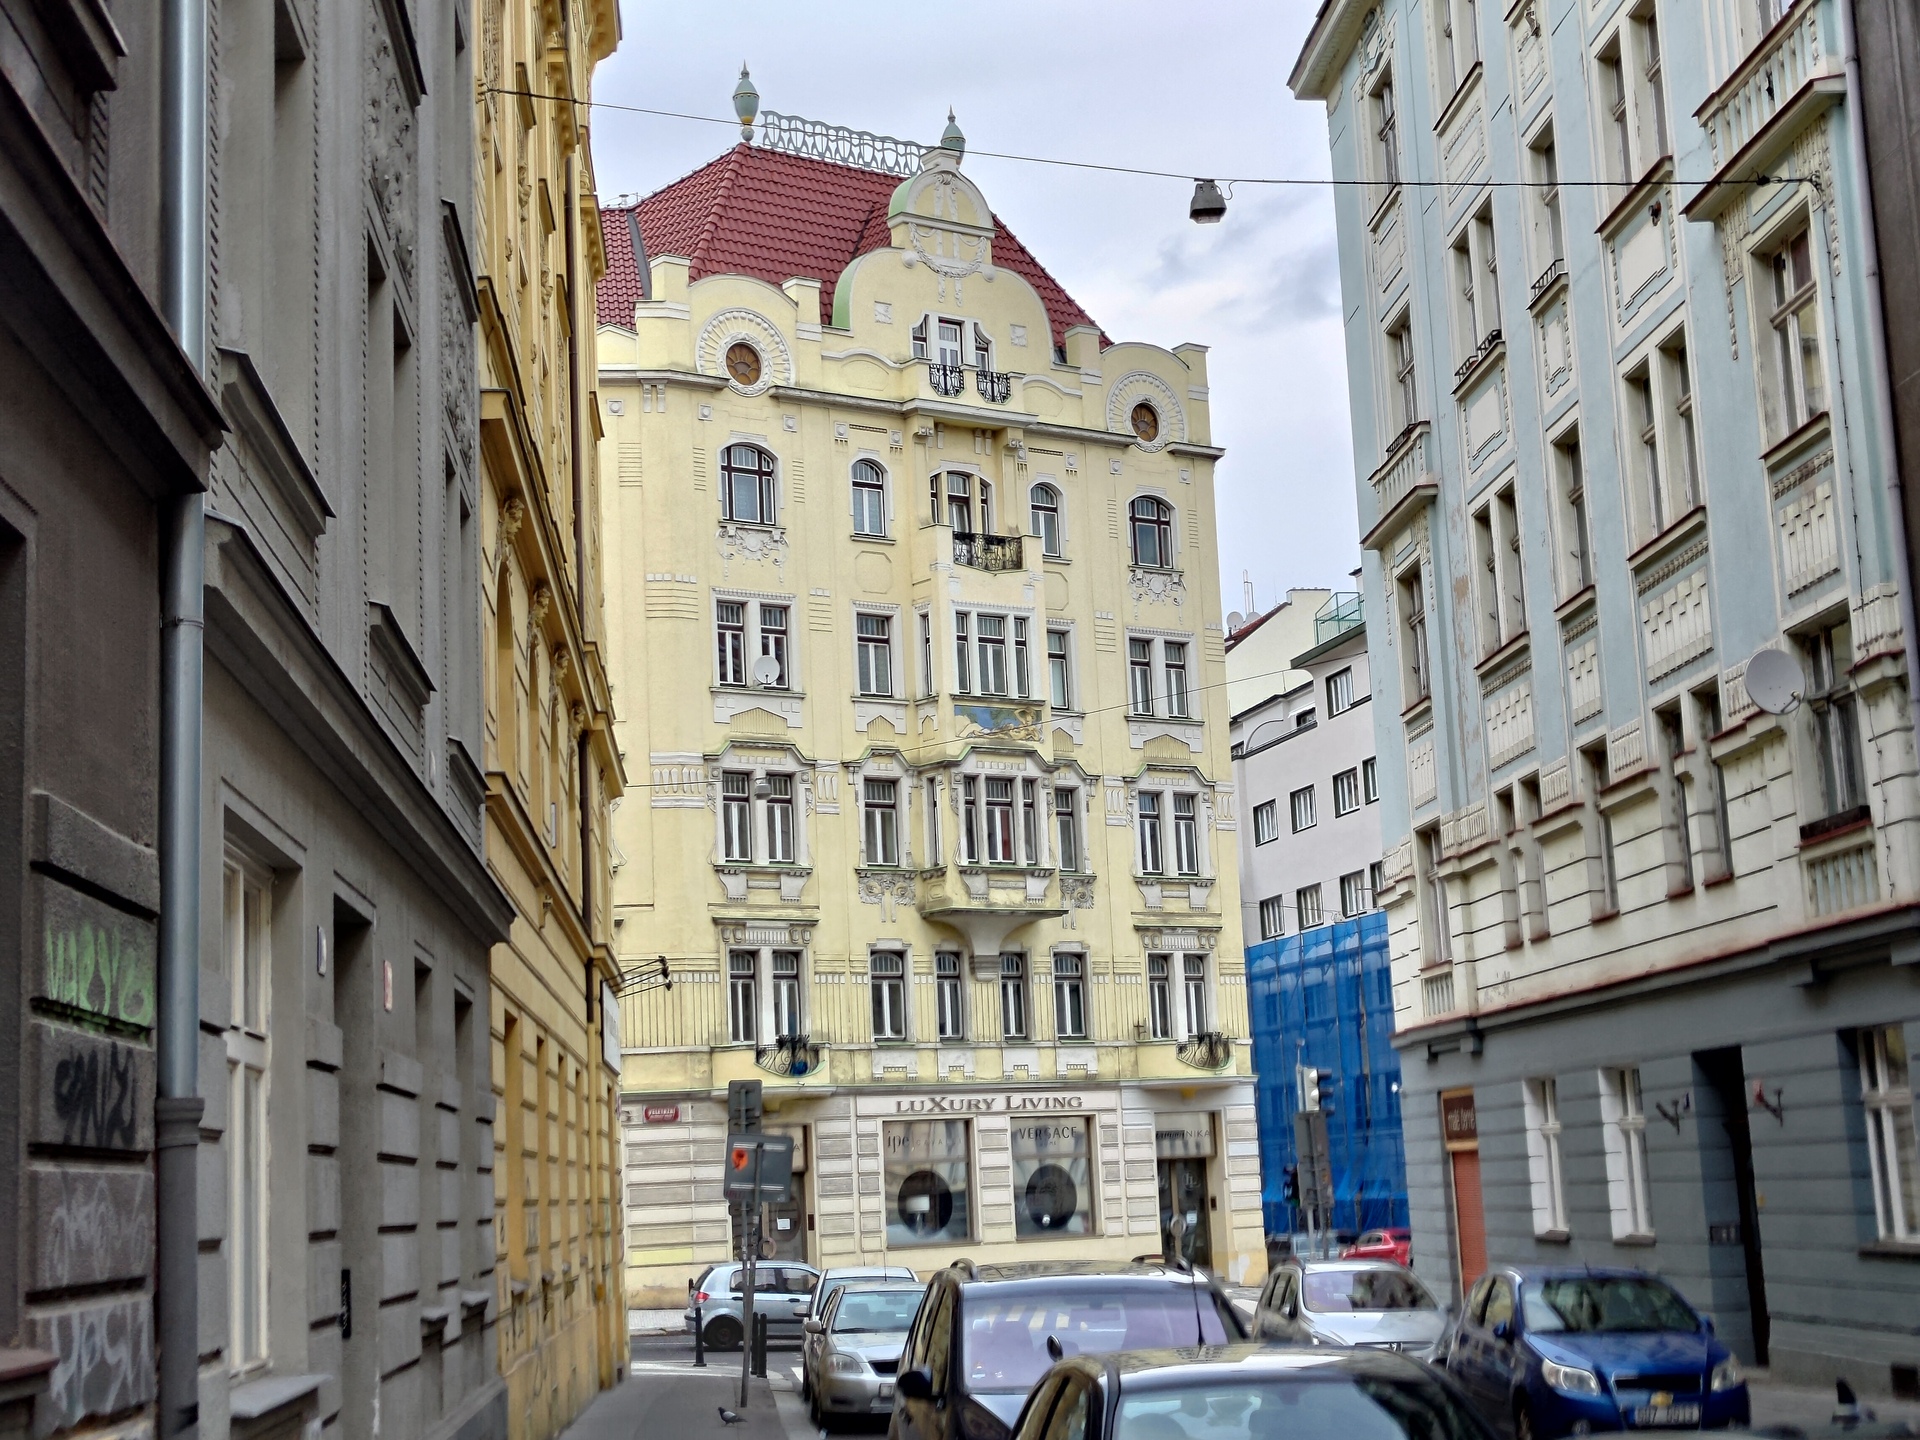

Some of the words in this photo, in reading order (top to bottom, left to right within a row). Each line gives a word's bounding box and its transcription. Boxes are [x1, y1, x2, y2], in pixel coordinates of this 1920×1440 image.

[896, 1096, 997, 1113] LUXURY
[1005, 1095, 1084, 1110] LIVING
[1018, 1126, 1078, 1141] VERSACE
